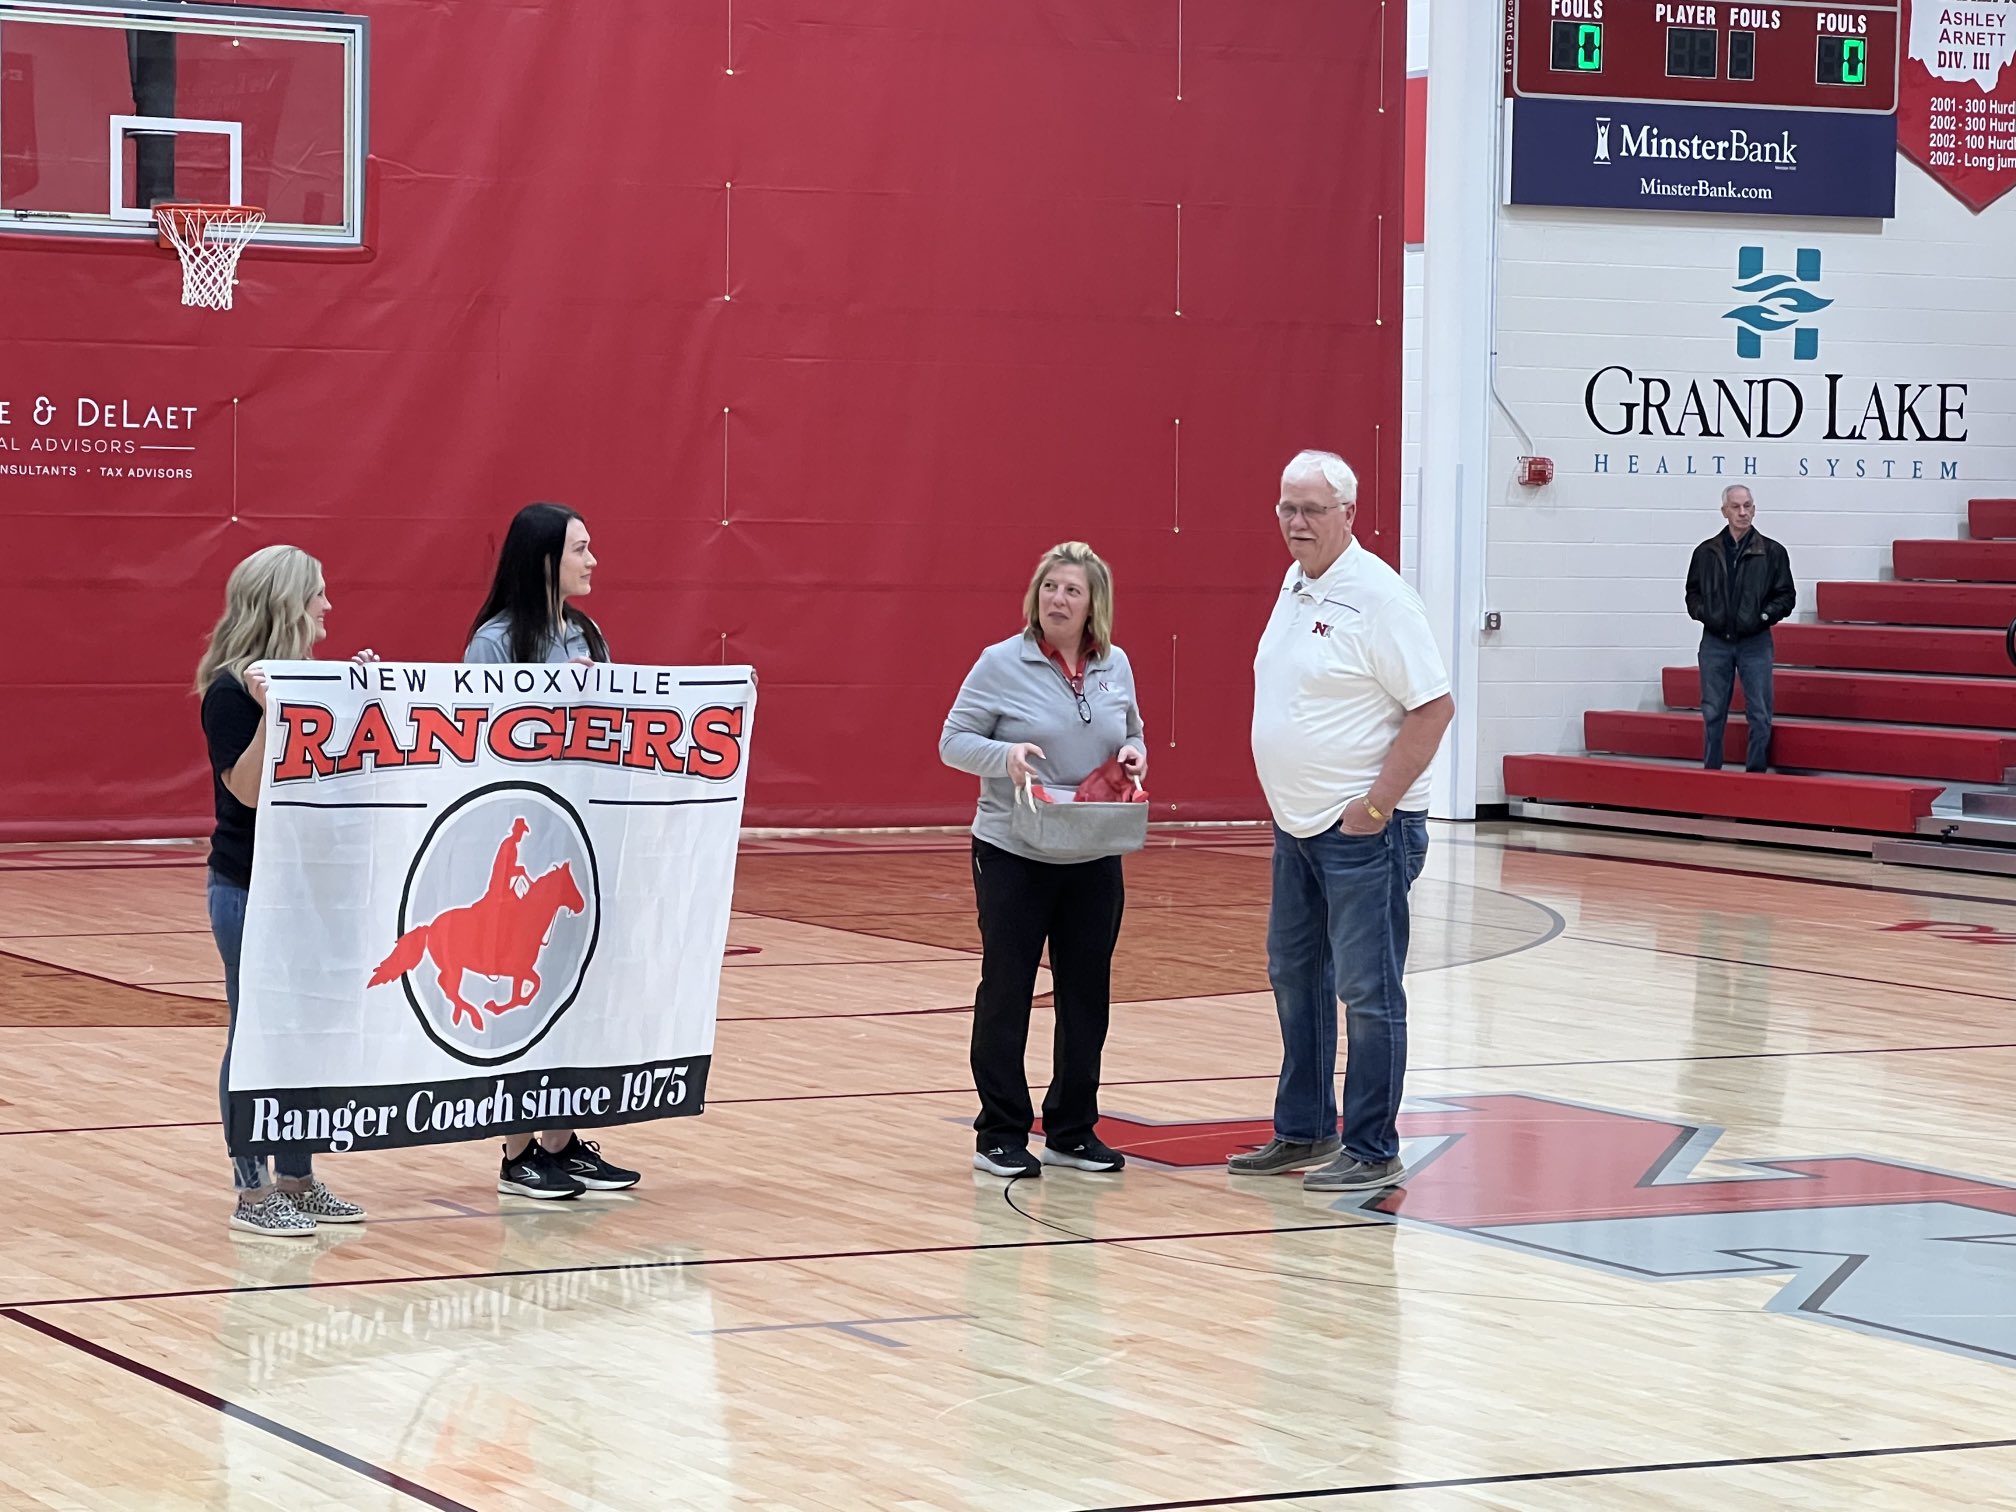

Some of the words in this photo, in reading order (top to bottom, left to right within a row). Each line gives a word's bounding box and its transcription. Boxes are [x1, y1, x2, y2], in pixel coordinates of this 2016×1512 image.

[1551, 0, 1603, 19] FOULS
[1655, 4, 1716, 25] PLAYER
[1730, 8, 1781, 29] FOULS
[1939, 9, 2006, 27] ASHLEY
[1817, 12, 1867, 34] FOULS
[1578, 25, 1600, 69] 0
[1938, 28, 2006, 46] ARNETT
[1842, 39, 1864, 83] 0
[1937, 51, 1967, 69] DIV.
[1973, 52, 1990, 70] III
[1930, 97, 1956, 112] 2001
[1965, 99, 1987, 113] 300
[1929, 115, 1956, 130] 2002
[1965, 117, 1987, 132] 300
[1620, 124, 1798, 164] MinsterBank
[1929, 133, 1956, 148] 2002
[1965, 135, 1985, 150] 100
[1929, 151, 1955, 166] 2002
[1964, 152, 1995, 171] Long
[1640, 178, 1773, 200] MinsterBank.com
[33, 396, 56, 426] &
[1584, 365, 1804, 438] GRAND
[1822, 373, 1969, 442] LAKE
[30, 438, 135, 454] ADVISORS
[0, 464, 77, 477] NSULTANTS
[100, 467, 123, 478] TAX
[128, 468, 193, 480] ADVISORS
[1594, 453, 1757, 475] HEALTH
[1799, 458, 1959, 478] SYSTEM
[349, 667, 426, 692] NEW
[454, 669, 671, 695] KNOXVILLE
[271, 699, 744, 785] RANGERS
[249, 1096, 398, 1153] Ranger
[406, 1080, 515, 1133] Coach
[521, 1075, 611, 1121] since
[616, 1064, 689, 1114] 1975
